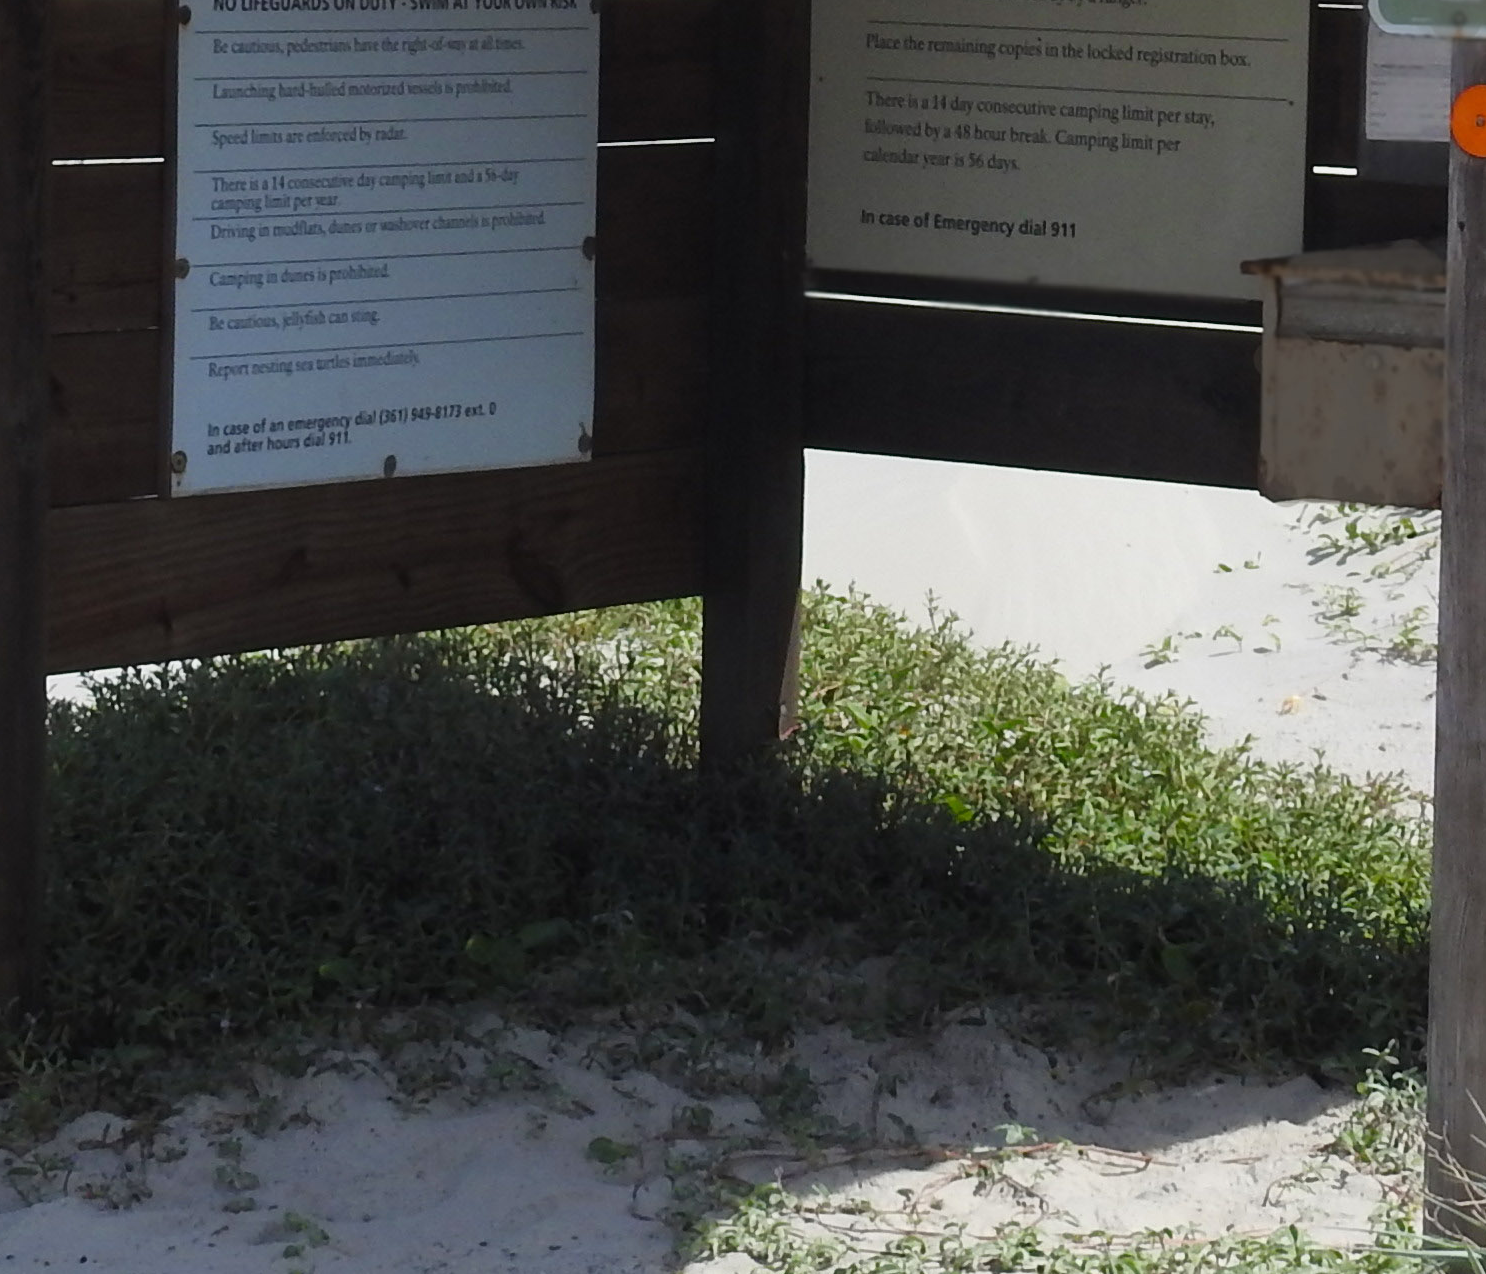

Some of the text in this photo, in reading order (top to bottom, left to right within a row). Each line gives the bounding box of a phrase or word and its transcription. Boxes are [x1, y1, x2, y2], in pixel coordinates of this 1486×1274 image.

[865, 32, 900, 50] Place
[903, 34, 924, 51] the
[927, 39, 996, 58] remaining
[1045, 42, 1058, 57] in
[1061, 42, 1083, 59] the
[1087, 43, 1133, 61] locked
[1136, 48, 1217, 67] registration
[1219, 48, 1251, 66] box.
[866, 90, 905, 108] There
[907, 93, 918, 109] is
[949, 95, 973, 115] day
[1059, 103, 1119, 124] camping
[1121, 104, 1153, 122] limit
[1157, 110, 1181, 127] per
[1184, 109, 1215, 129] stay,
[924, 121, 940, 142] by
[954, 123, 971, 139] 48
[973, 123, 1006, 141] hour
[1054, 129, 1119, 152] Camping
[1121, 132, 1153, 150] limit
[1157, 138, 1181, 155] per
[954, 152, 964, 167] is
[861, 208, 1075, 238] In case of Emergency dial 911
[207, 401, 496, 437] In case of an emergency dial (361) 949-8173 ext. 0
[206, 429, 351, 455] and after hours dial 911.
